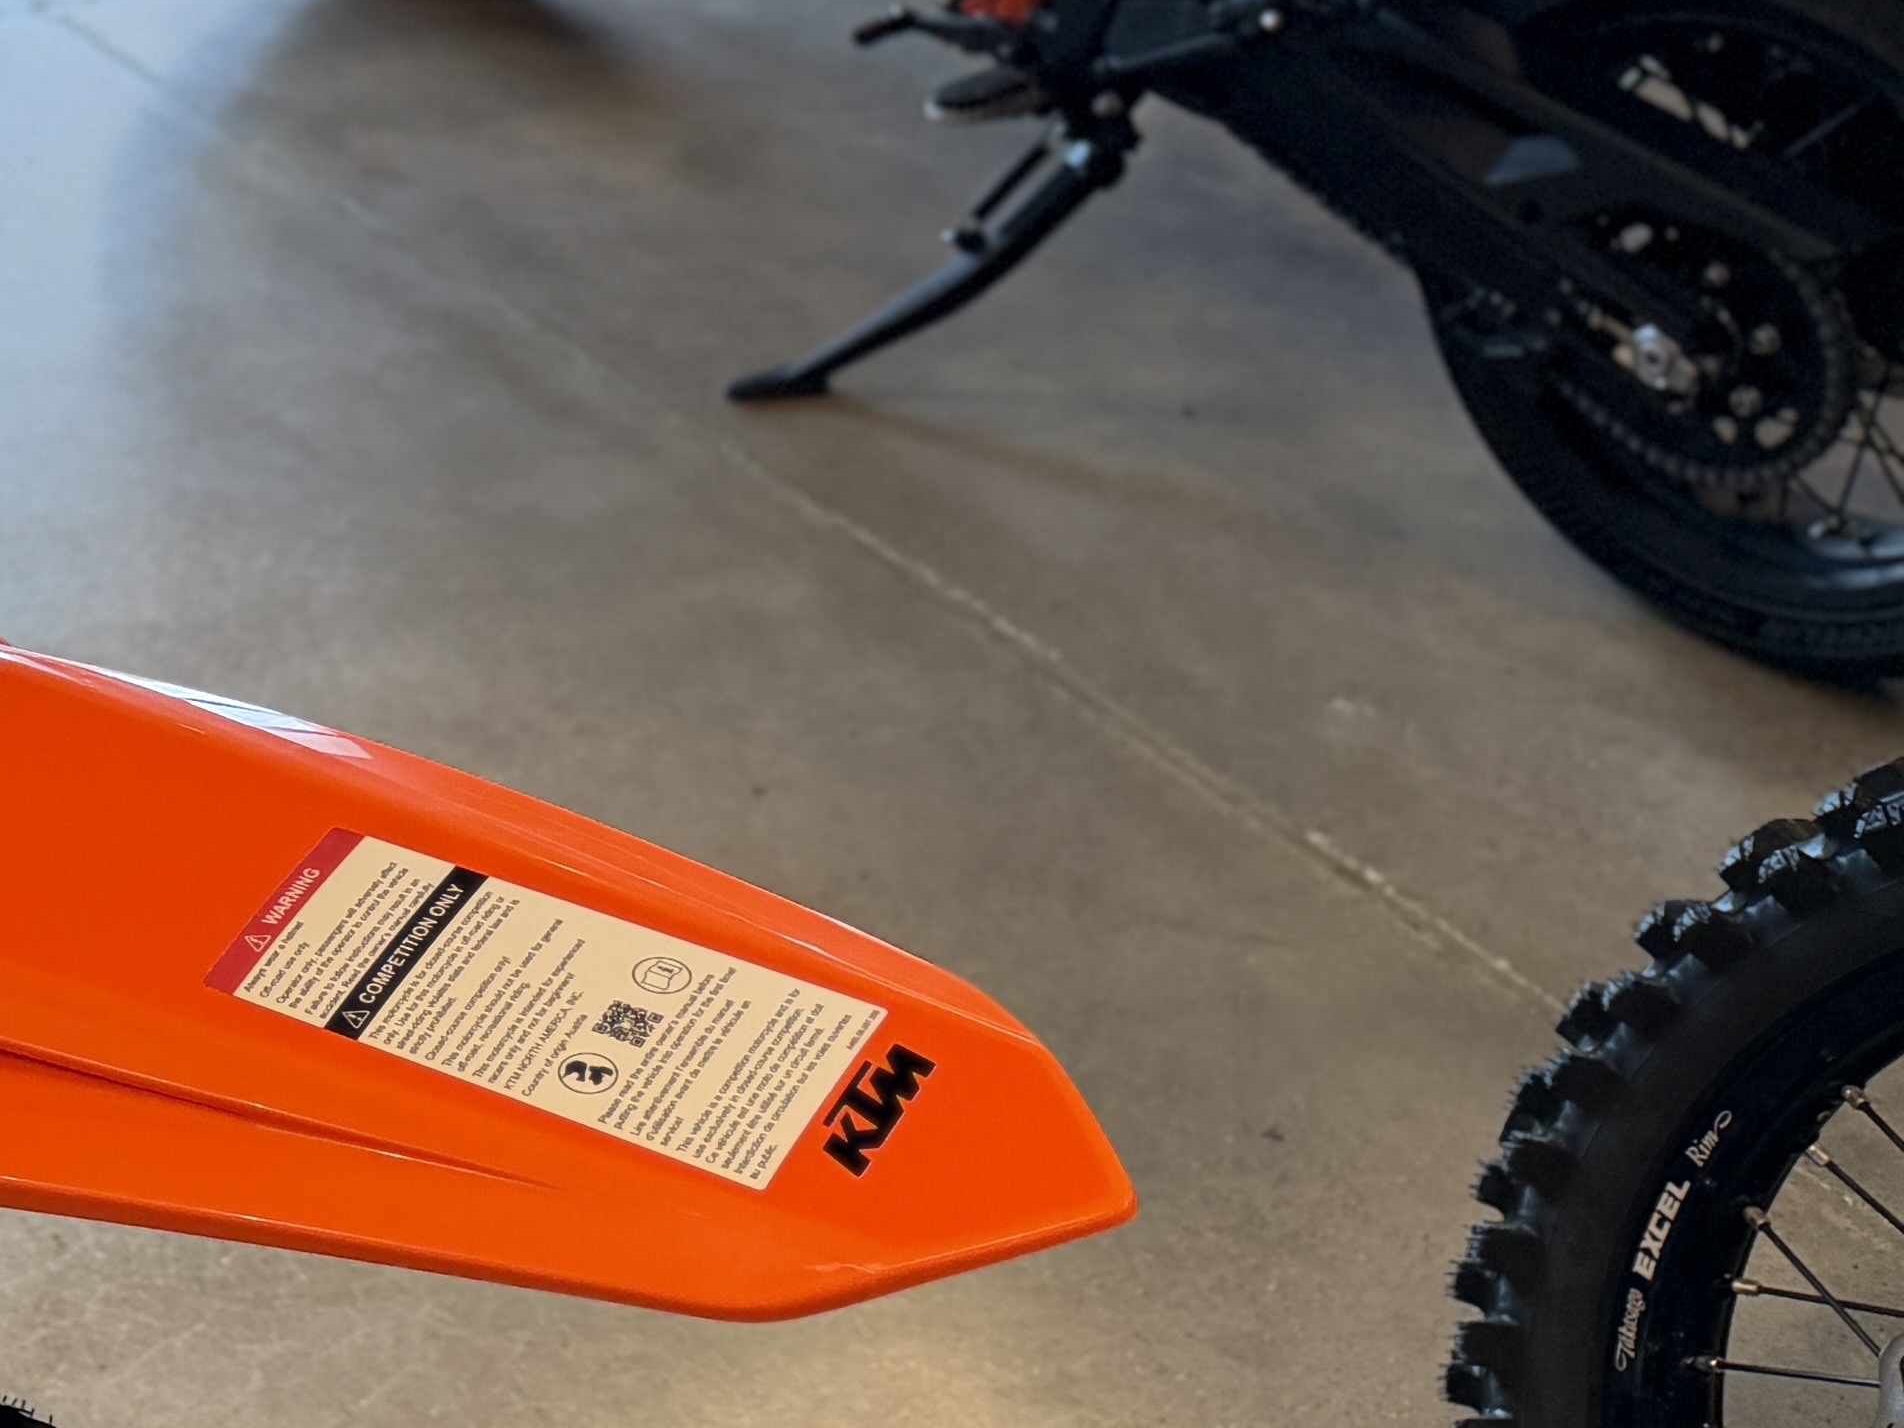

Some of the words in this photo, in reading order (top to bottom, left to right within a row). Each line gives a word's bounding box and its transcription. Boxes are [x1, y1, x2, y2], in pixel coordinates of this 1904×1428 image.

[260, 867, 320, 924] WARNING
[358, 916, 437, 1003] COMPETITION
[429, 883, 463, 916] ONLY
[503, 1071, 521, 1090] KTM
[516, 1042, 544, 1072] NORTH
[822, 1043, 937, 1177] KTM
[1632, 1179, 1691, 1281] EXCEL
[1685, 1110, 1733, 1169] Rim
